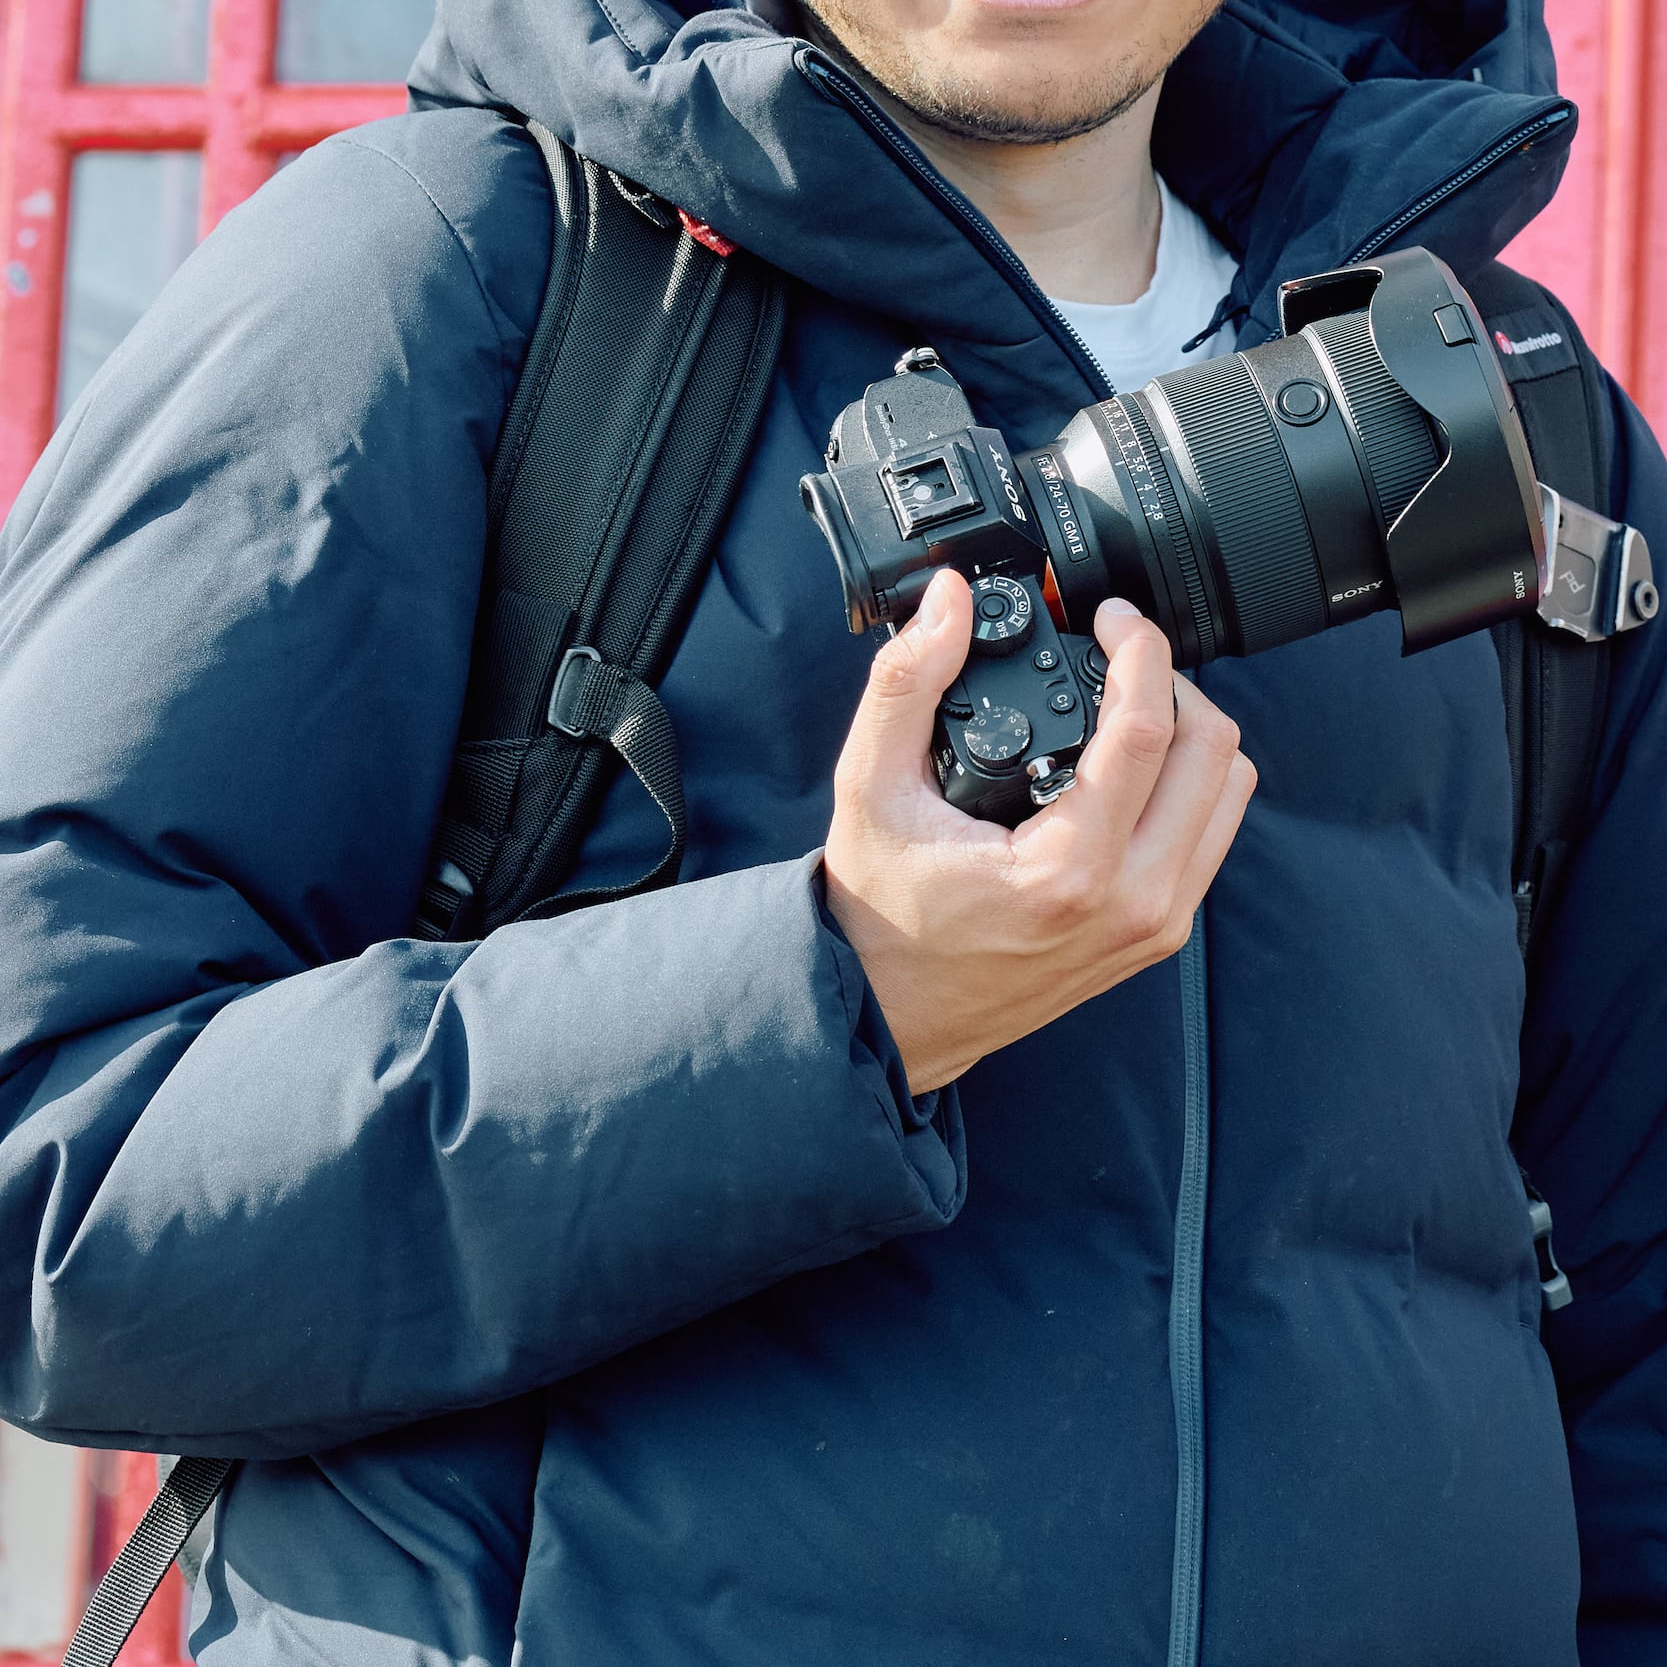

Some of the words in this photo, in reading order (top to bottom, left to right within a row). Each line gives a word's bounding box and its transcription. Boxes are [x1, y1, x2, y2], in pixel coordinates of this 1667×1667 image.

[1113, 410, 1124, 418] 16
[1118, 422, 1130, 432] 11
[1126, 440, 1137, 449] 8
[1132, 456, 1147, 473] 5.6
[988, 444, 1028, 522] SONY
[1143, 483, 1154, 491] 4
[1037, 456, 1050, 467] FE
[1063, 520, 1080, 544] GM
[1149, 502, 1164, 521] 2.8
[1331, 579, 1384, 603] SONY
[1513, 570, 1526, 600] SONY
[977, 577, 991, 590] M
[1011, 586, 1023, 598] 2
[1018, 600, 1027, 612] 3
[1040, 650, 1053, 667] C2
[1056, 694, 1068, 709] C1
